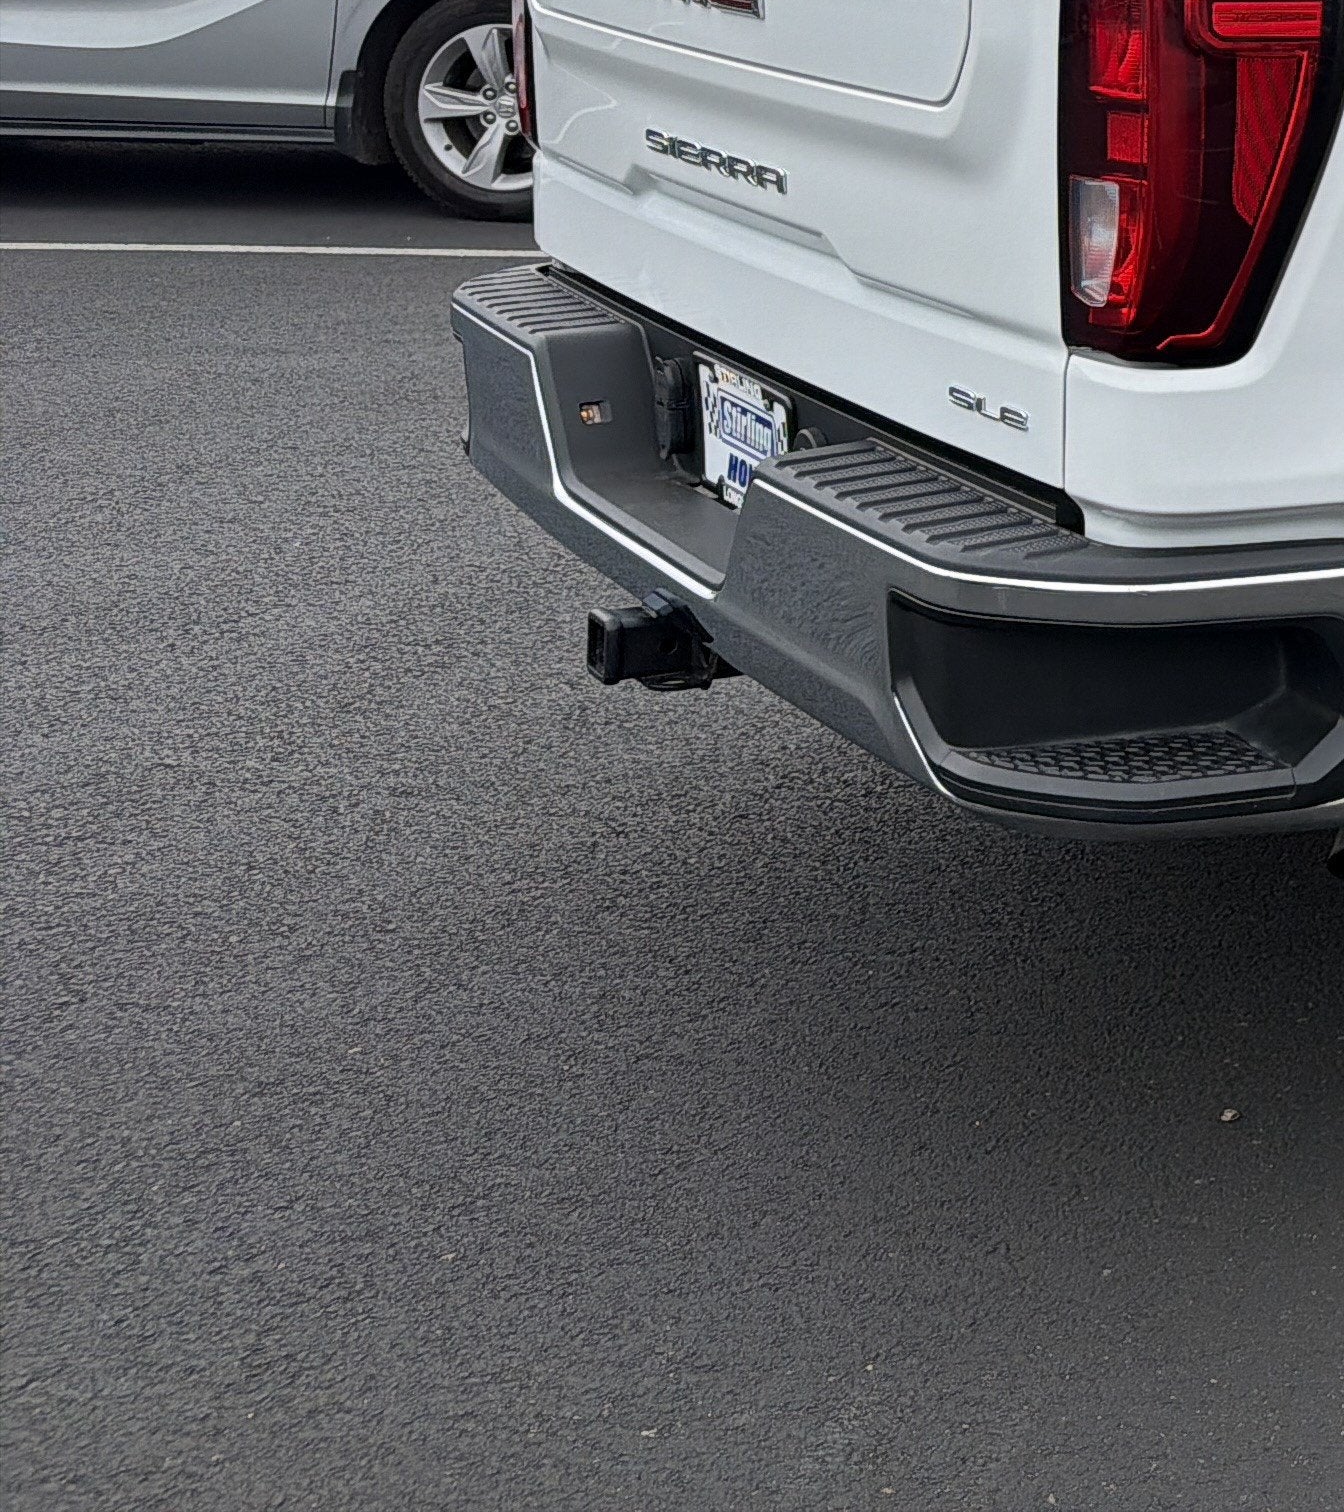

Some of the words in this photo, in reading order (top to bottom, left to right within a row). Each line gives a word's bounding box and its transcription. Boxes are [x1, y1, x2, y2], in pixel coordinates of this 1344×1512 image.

[645, 127, 788, 195] SIERRA
[722, 399, 773, 461] Stirling
[948, 385, 1030, 432] SLE
